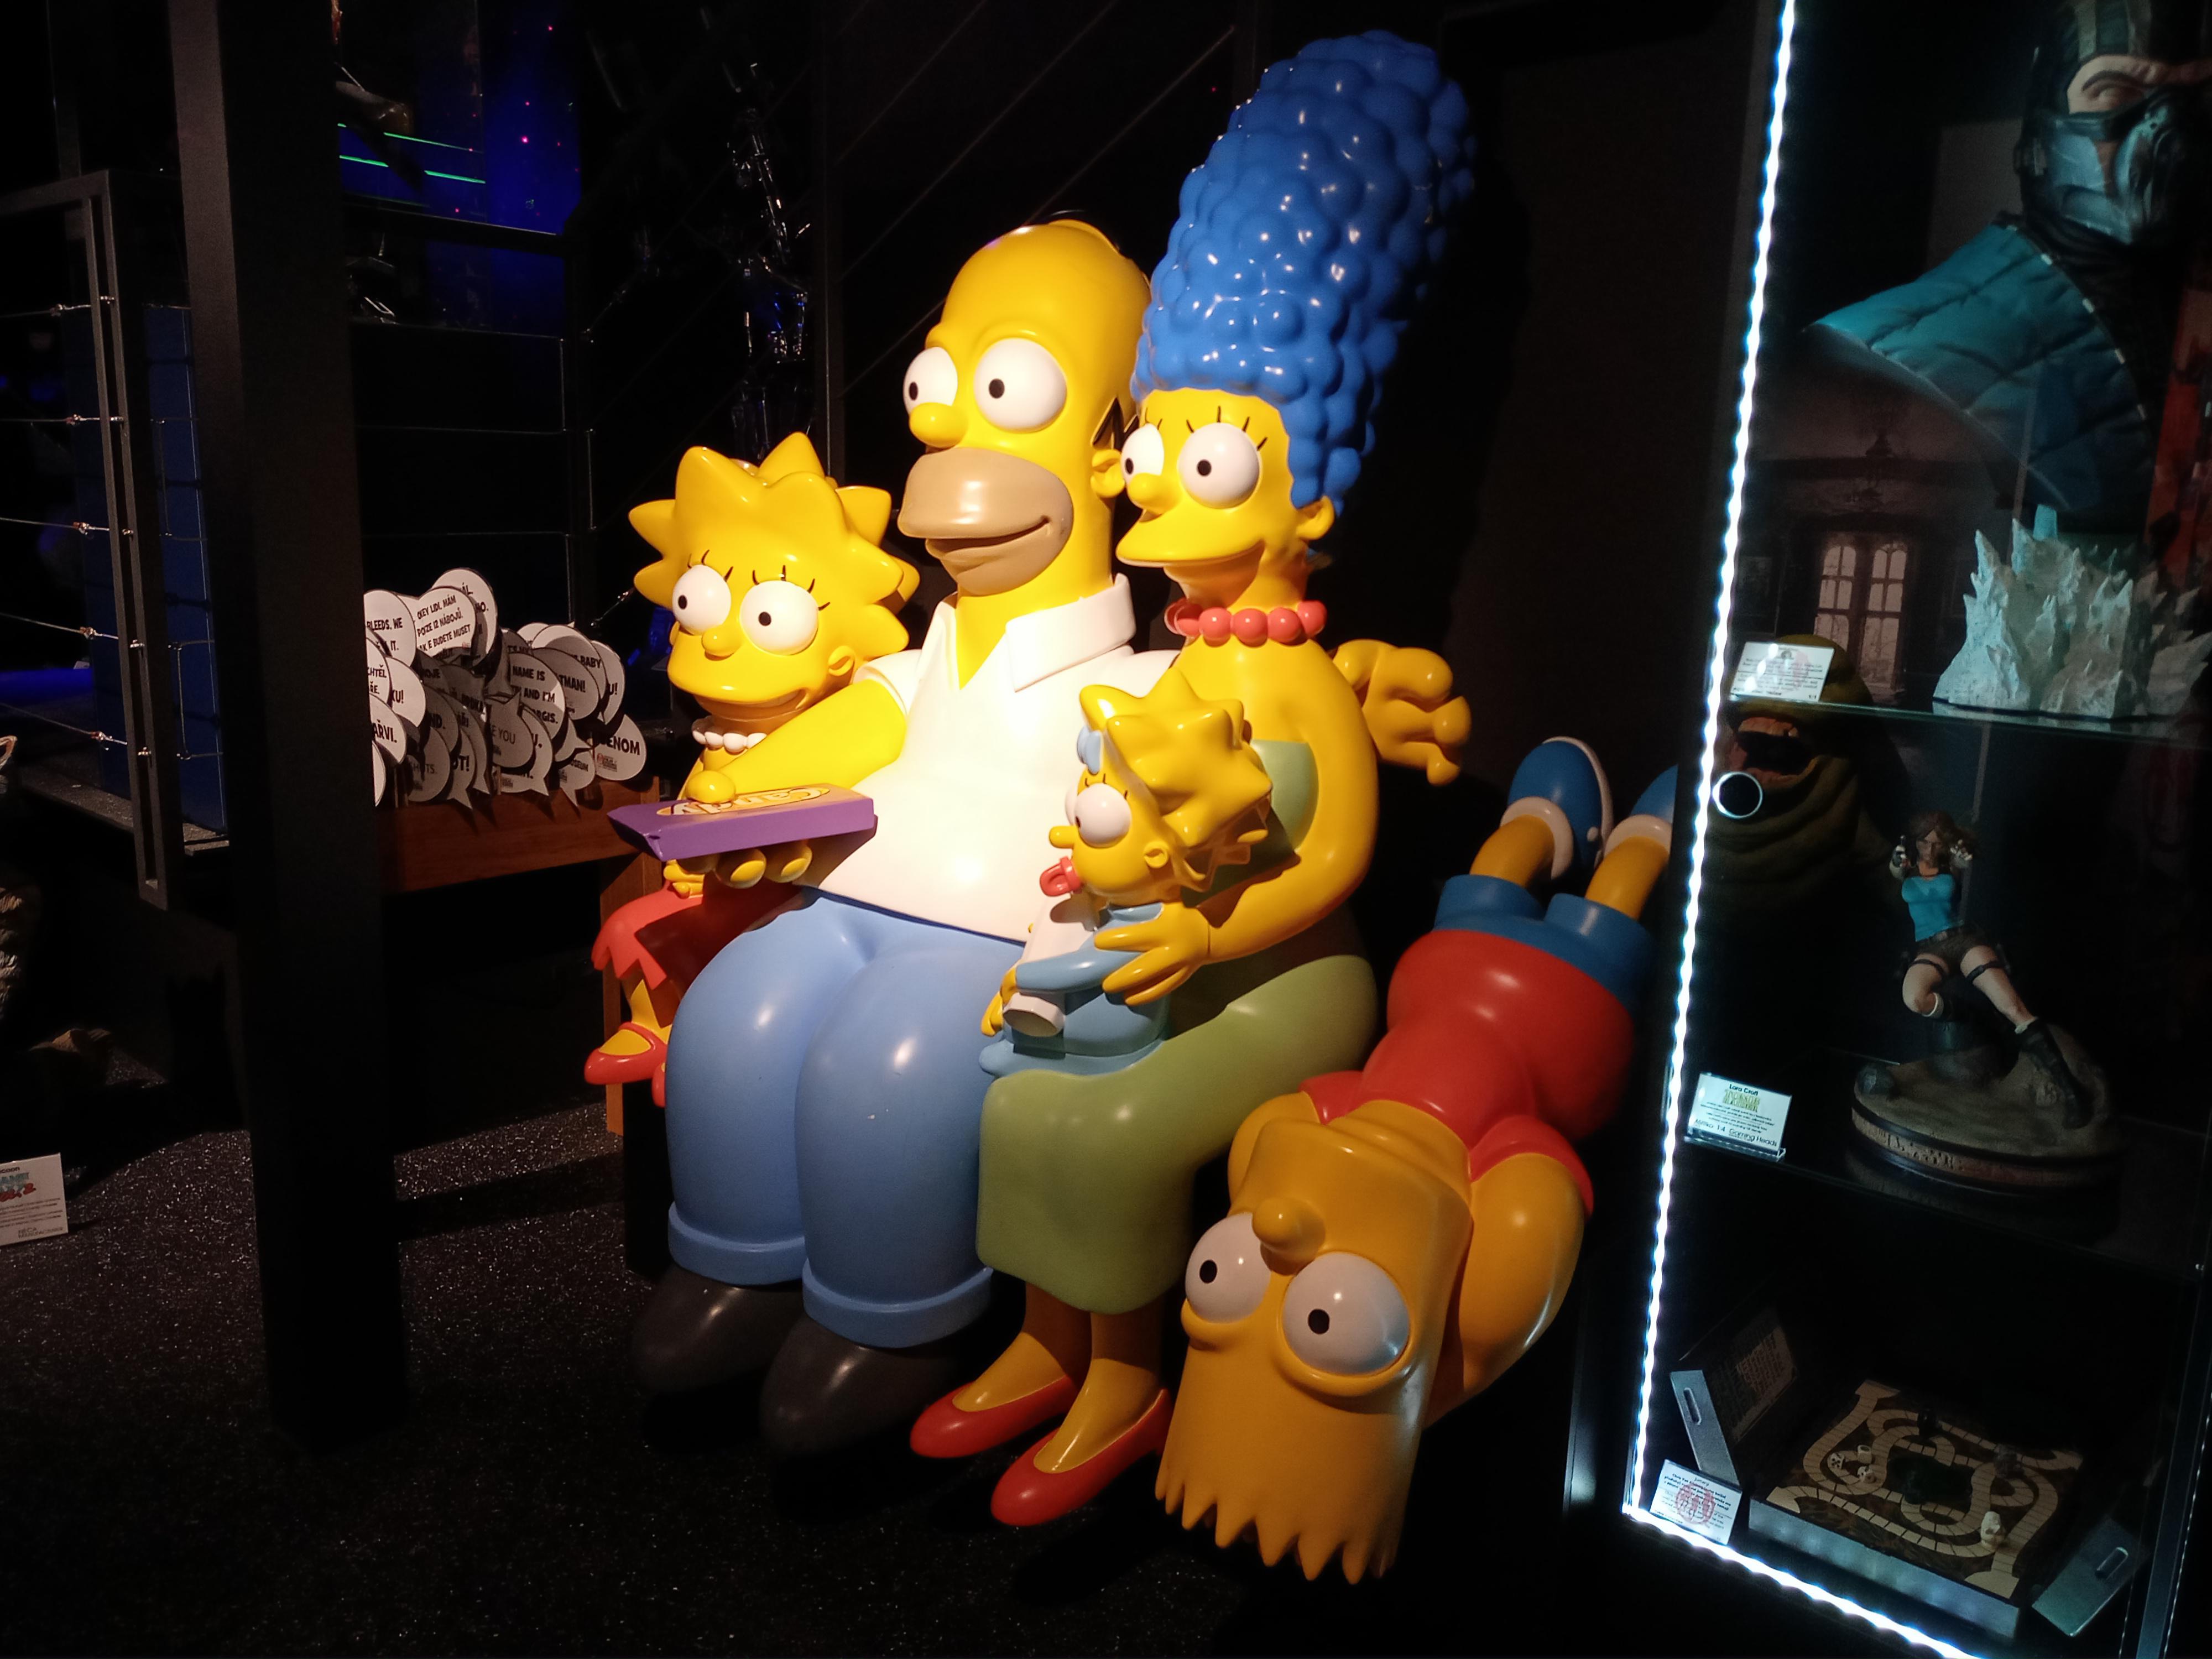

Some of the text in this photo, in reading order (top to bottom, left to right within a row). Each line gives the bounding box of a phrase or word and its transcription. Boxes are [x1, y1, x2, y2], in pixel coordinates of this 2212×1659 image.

[393, 618, 403, 629] WE
[581, 655, 602, 669] BABY
[513, 666, 545, 681] NAME IS
[556, 673, 586, 693] TMAN!
[524, 688, 539, 700] AND
[498, 729, 515, 744] YOU
[607, 735, 640, 755] ENOM
[1729, 1084, 1742, 1092] Lara
